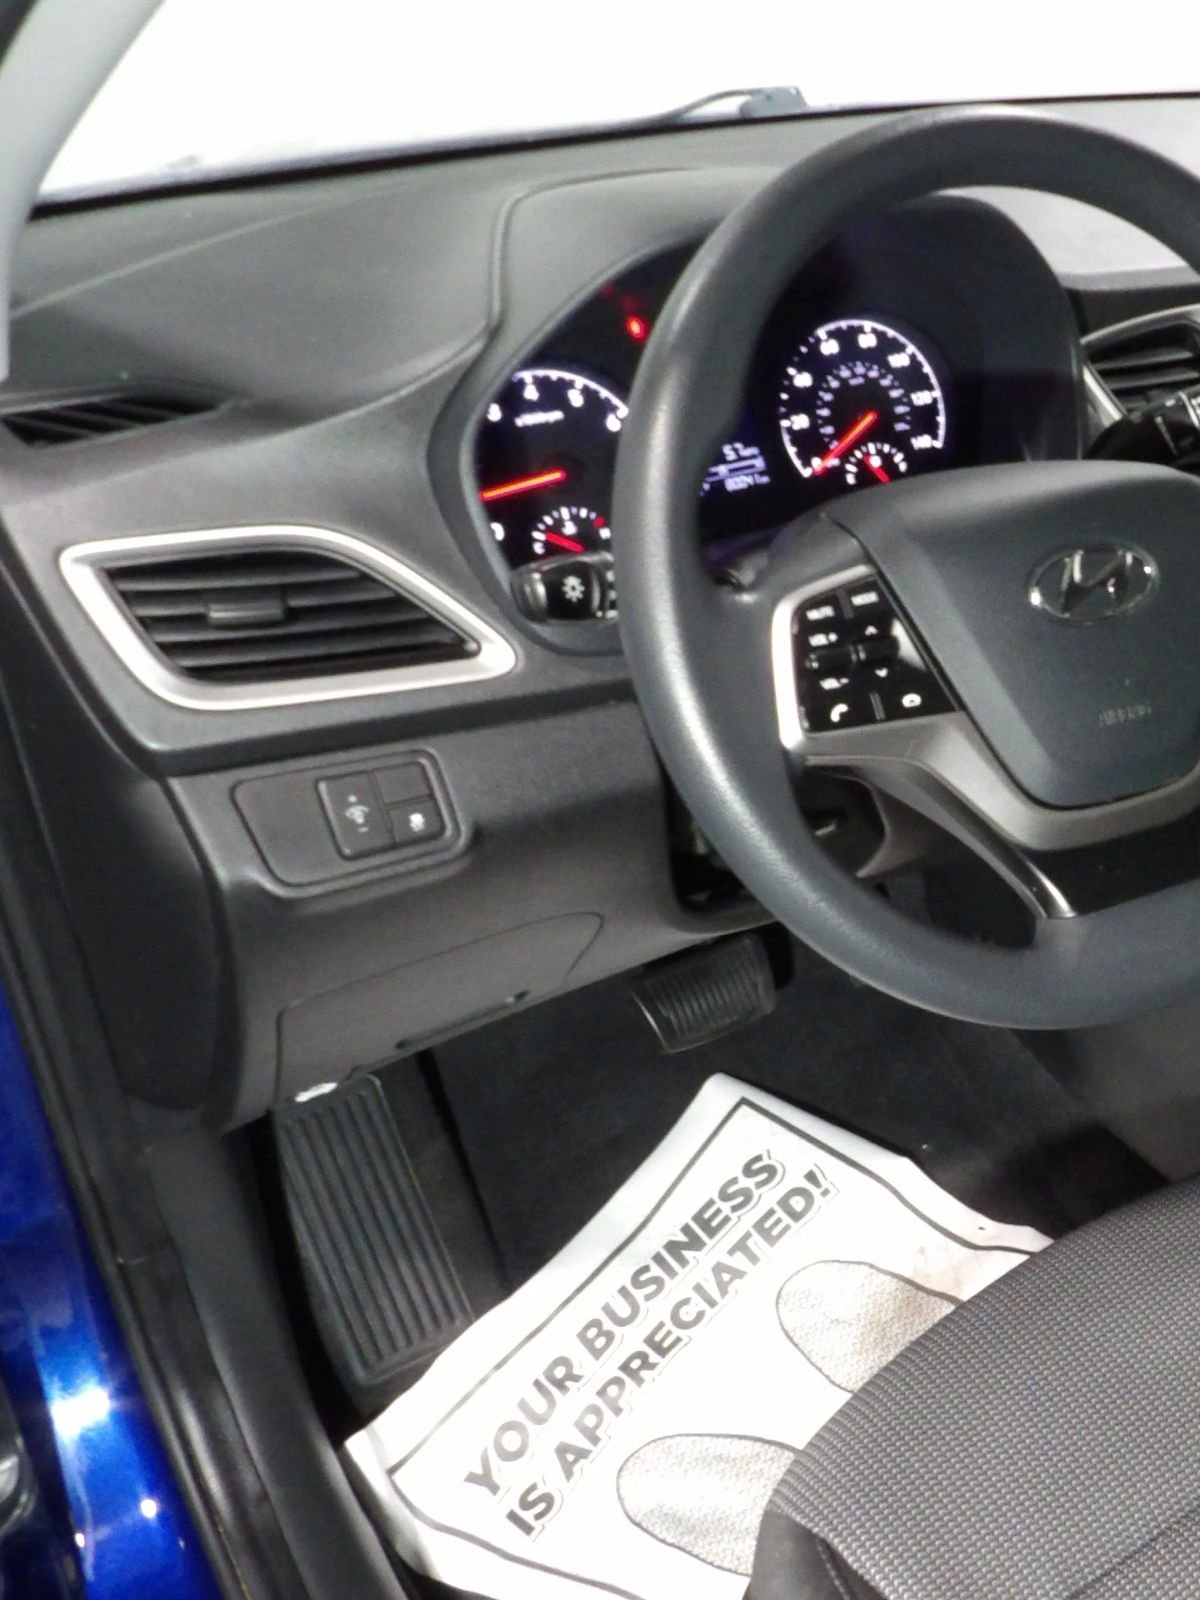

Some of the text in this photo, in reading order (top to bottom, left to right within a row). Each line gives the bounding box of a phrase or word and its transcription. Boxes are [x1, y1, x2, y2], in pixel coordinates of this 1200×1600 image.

[464, 1151, 781, 1497] YOUR BUSINESS
[506, 1167, 832, 1538] IS APPRECIATED!
